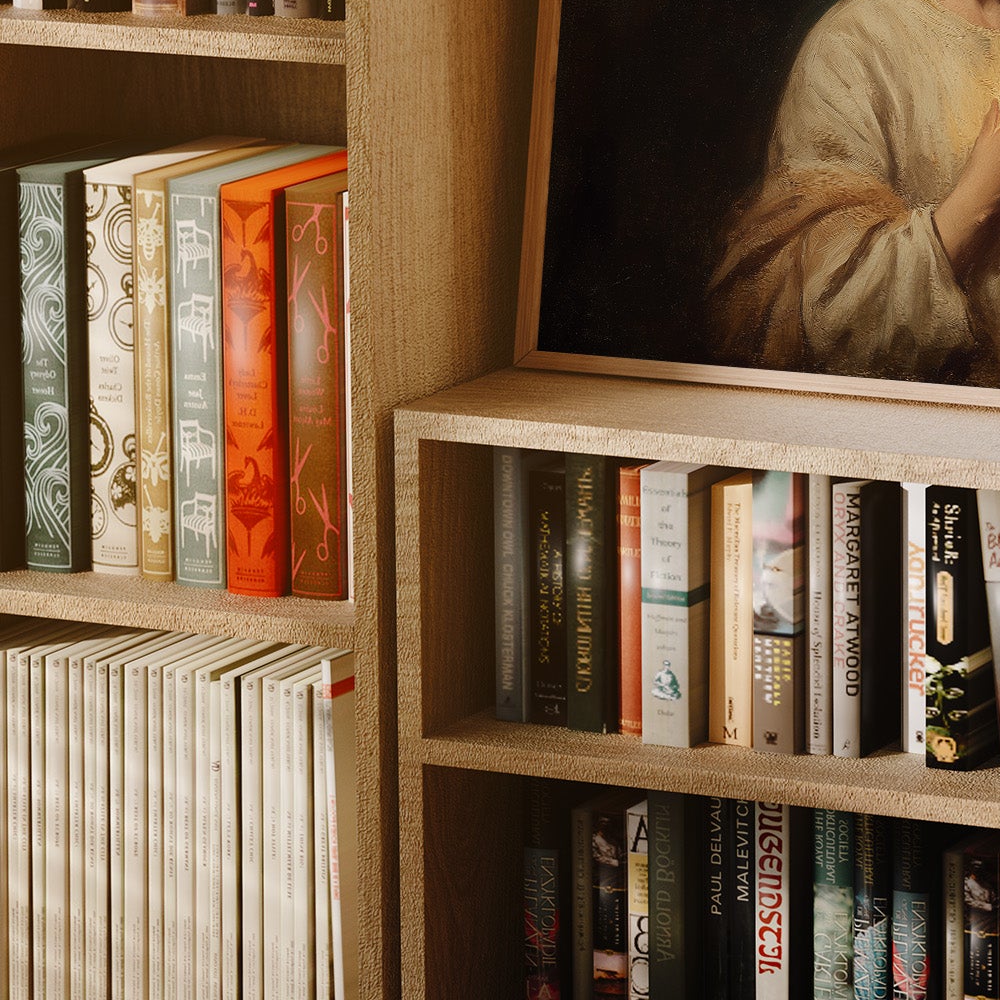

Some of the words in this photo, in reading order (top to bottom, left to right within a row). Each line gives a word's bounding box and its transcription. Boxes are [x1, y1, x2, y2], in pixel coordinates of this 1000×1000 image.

[832, 491, 846, 544] ORYX
[845, 492, 860, 606] MARGARET
[502, 609, 514, 690] KLOSTERMAN
[832, 599, 845, 670] CRAKE
[844, 610, 860, 697] ATWOOD
[709, 795, 722, 865] DELVAU
[709, 870, 722, 916] PAUL
